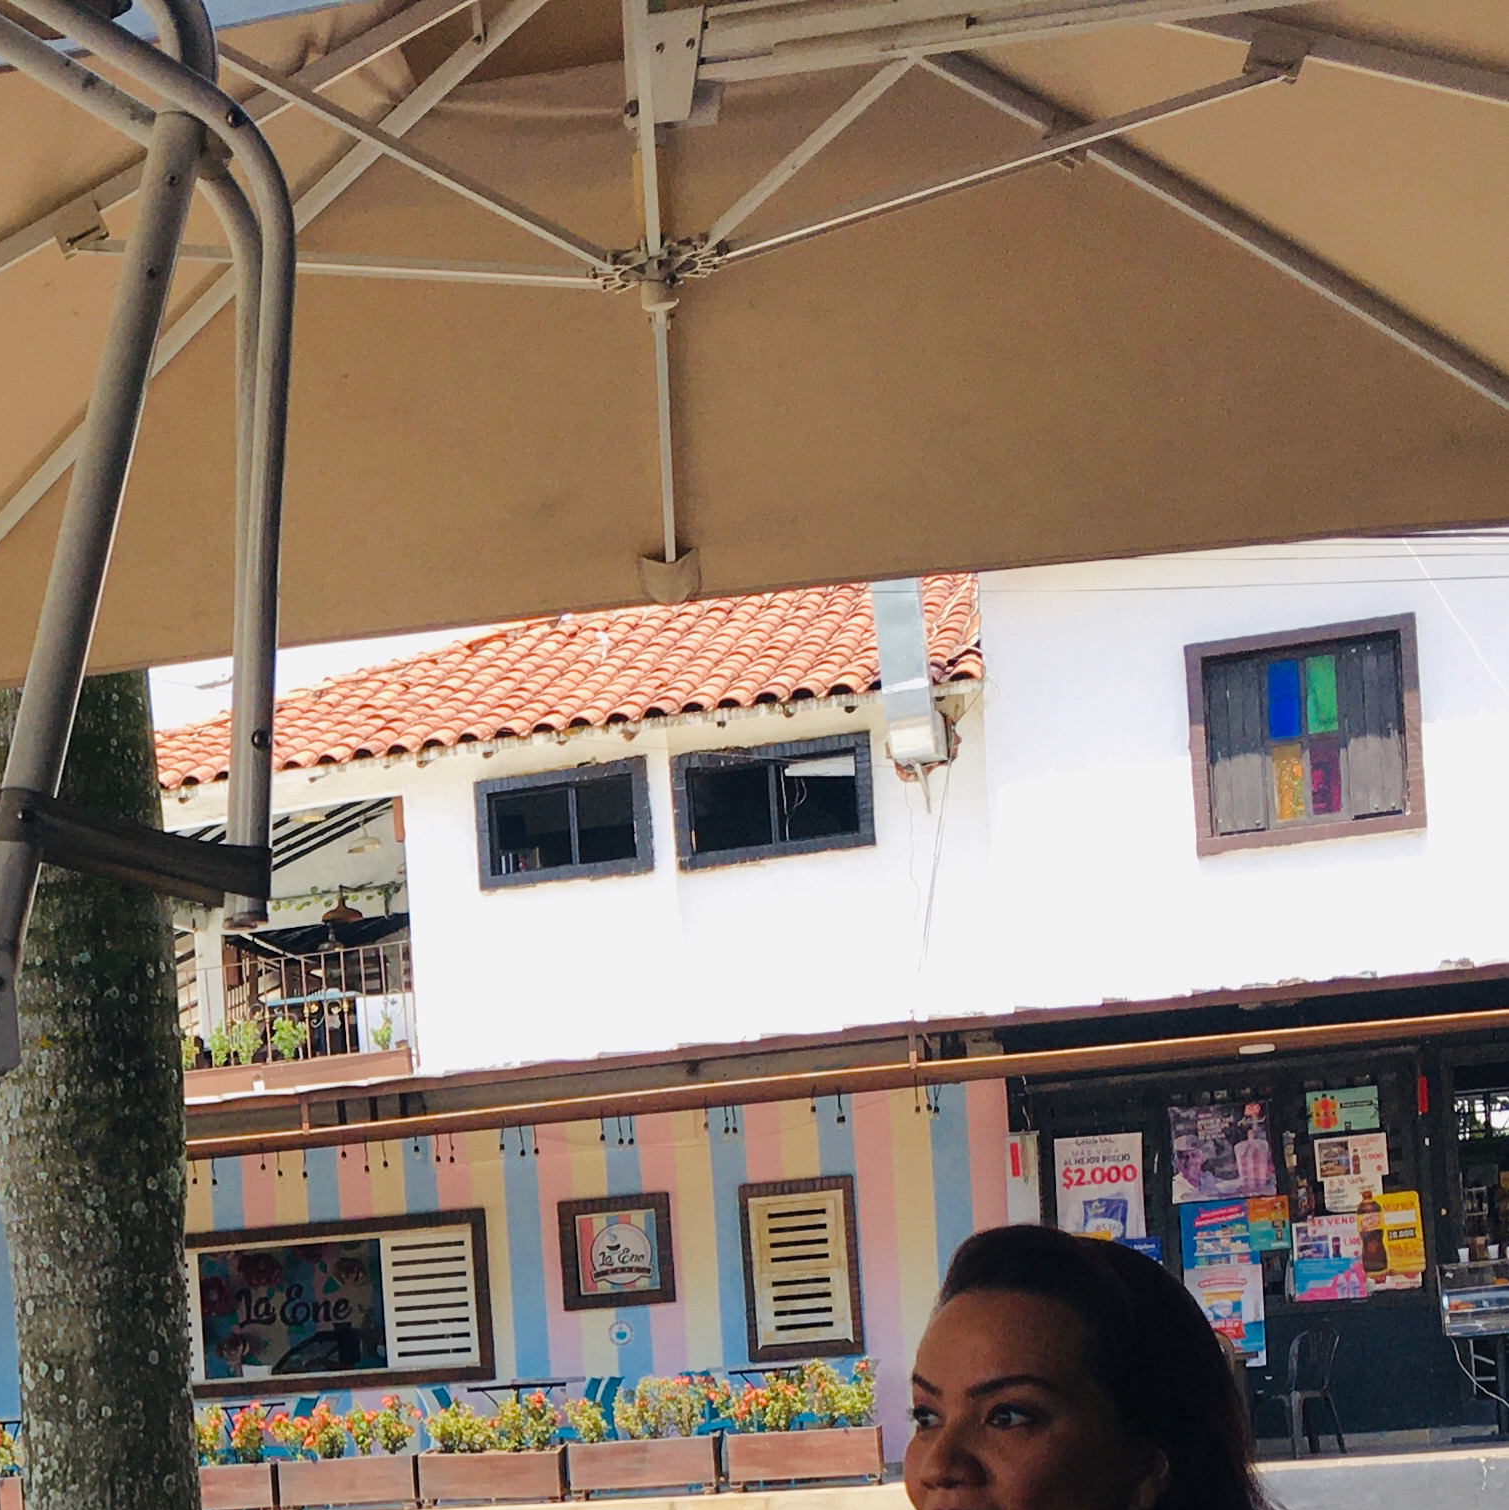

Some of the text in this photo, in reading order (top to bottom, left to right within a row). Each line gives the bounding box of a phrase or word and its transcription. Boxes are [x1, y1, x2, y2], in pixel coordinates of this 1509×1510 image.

[1074, 1156, 1100, 1165] MEJOR
[1102, 1153, 1131, 1163] PRECIO
[1061, 1164, 1138, 1190] $2.000
[1327, 1215, 1356, 1226] VEND
[599, 1251, 614, 1267] La
[236, 1288, 277, 1328] La
